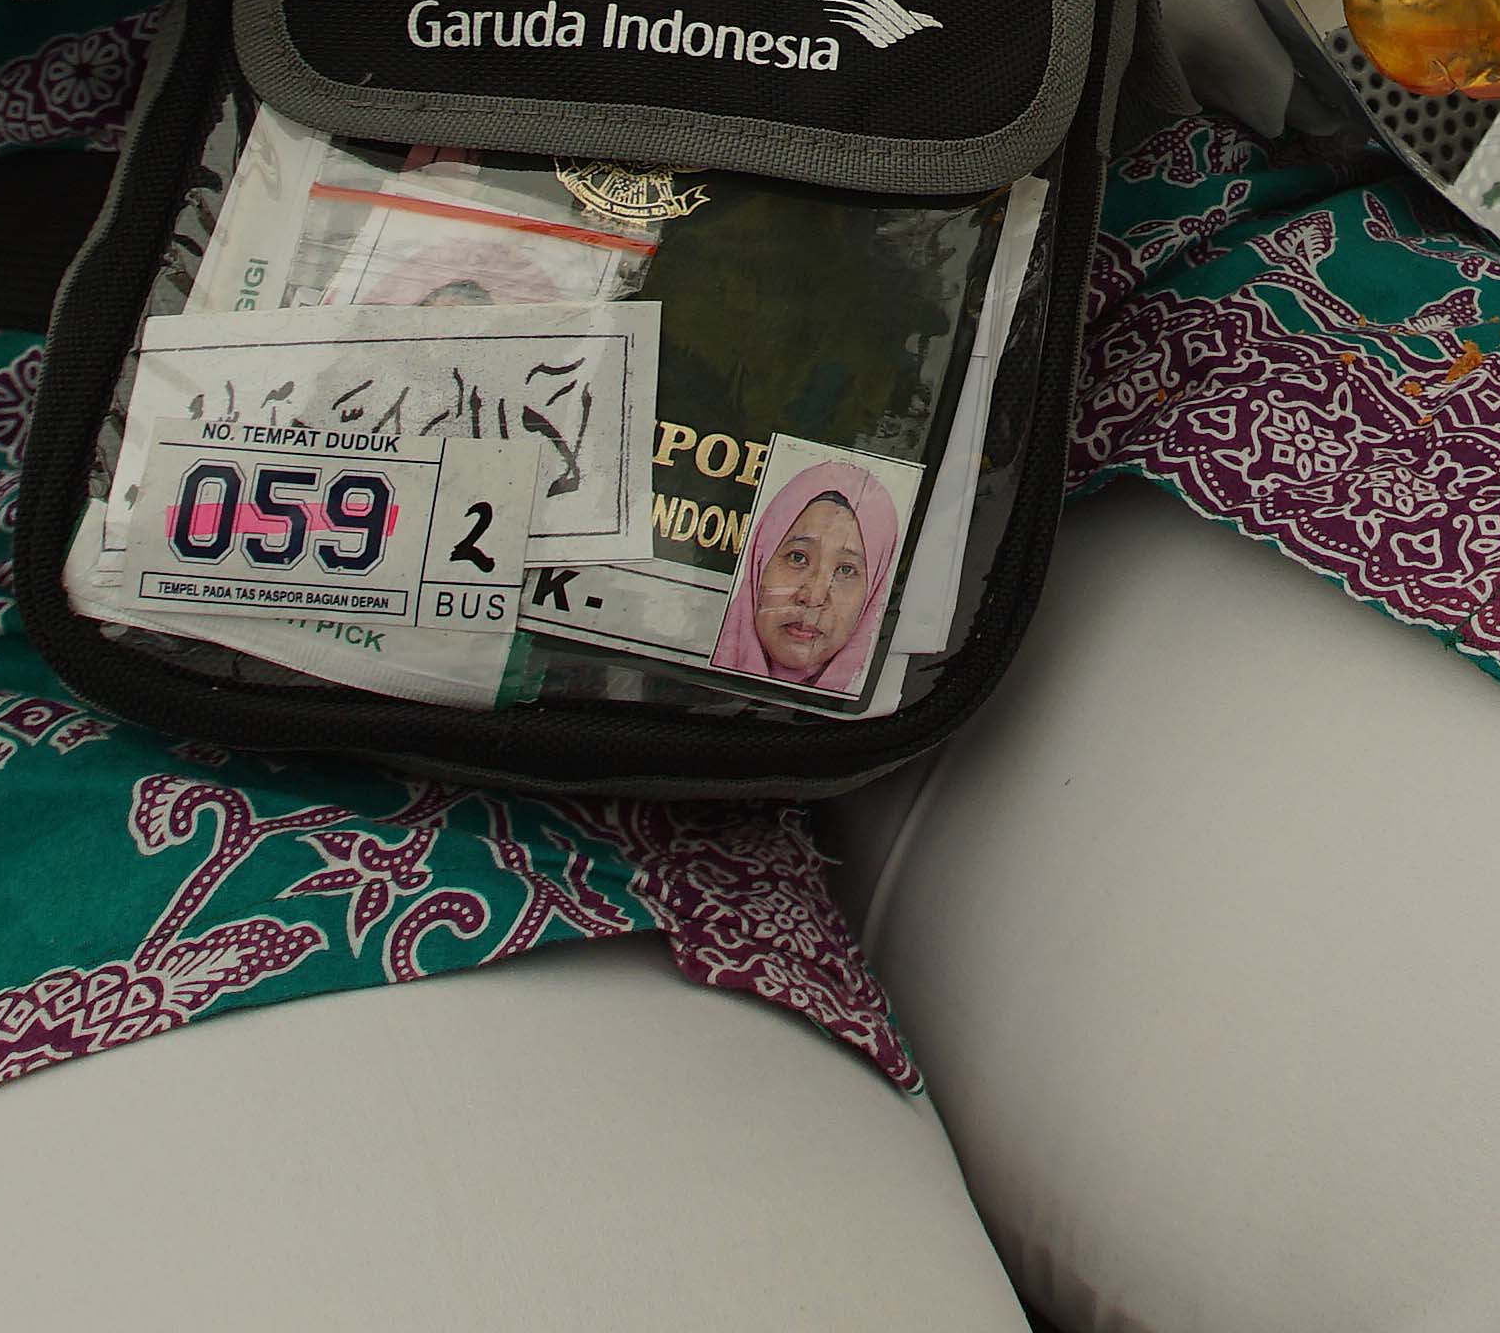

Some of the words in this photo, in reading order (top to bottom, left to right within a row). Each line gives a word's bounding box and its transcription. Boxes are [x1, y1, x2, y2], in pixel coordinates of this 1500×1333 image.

[600, 1, 841, 70] Indonesia
[202, 422, 237, 442] NO.
[240, 425, 321, 448] TEMPAT
[325, 431, 401, 454] DUDUK
[168, 459, 396, 576] 059
[449, 501, 495, 573] 2
[157, 580, 201, 596] TEMPEL
[202, 583, 232, 599] PADA
[234, 586, 256, 600] TAS
[258, 588, 303, 604] PASPOR
[304, 591, 349, 607] BAGIAN
[351, 594, 390, 610] DEPAN
[435, 590, 506, 621] BUS
[315, 620, 386, 653] PICK
